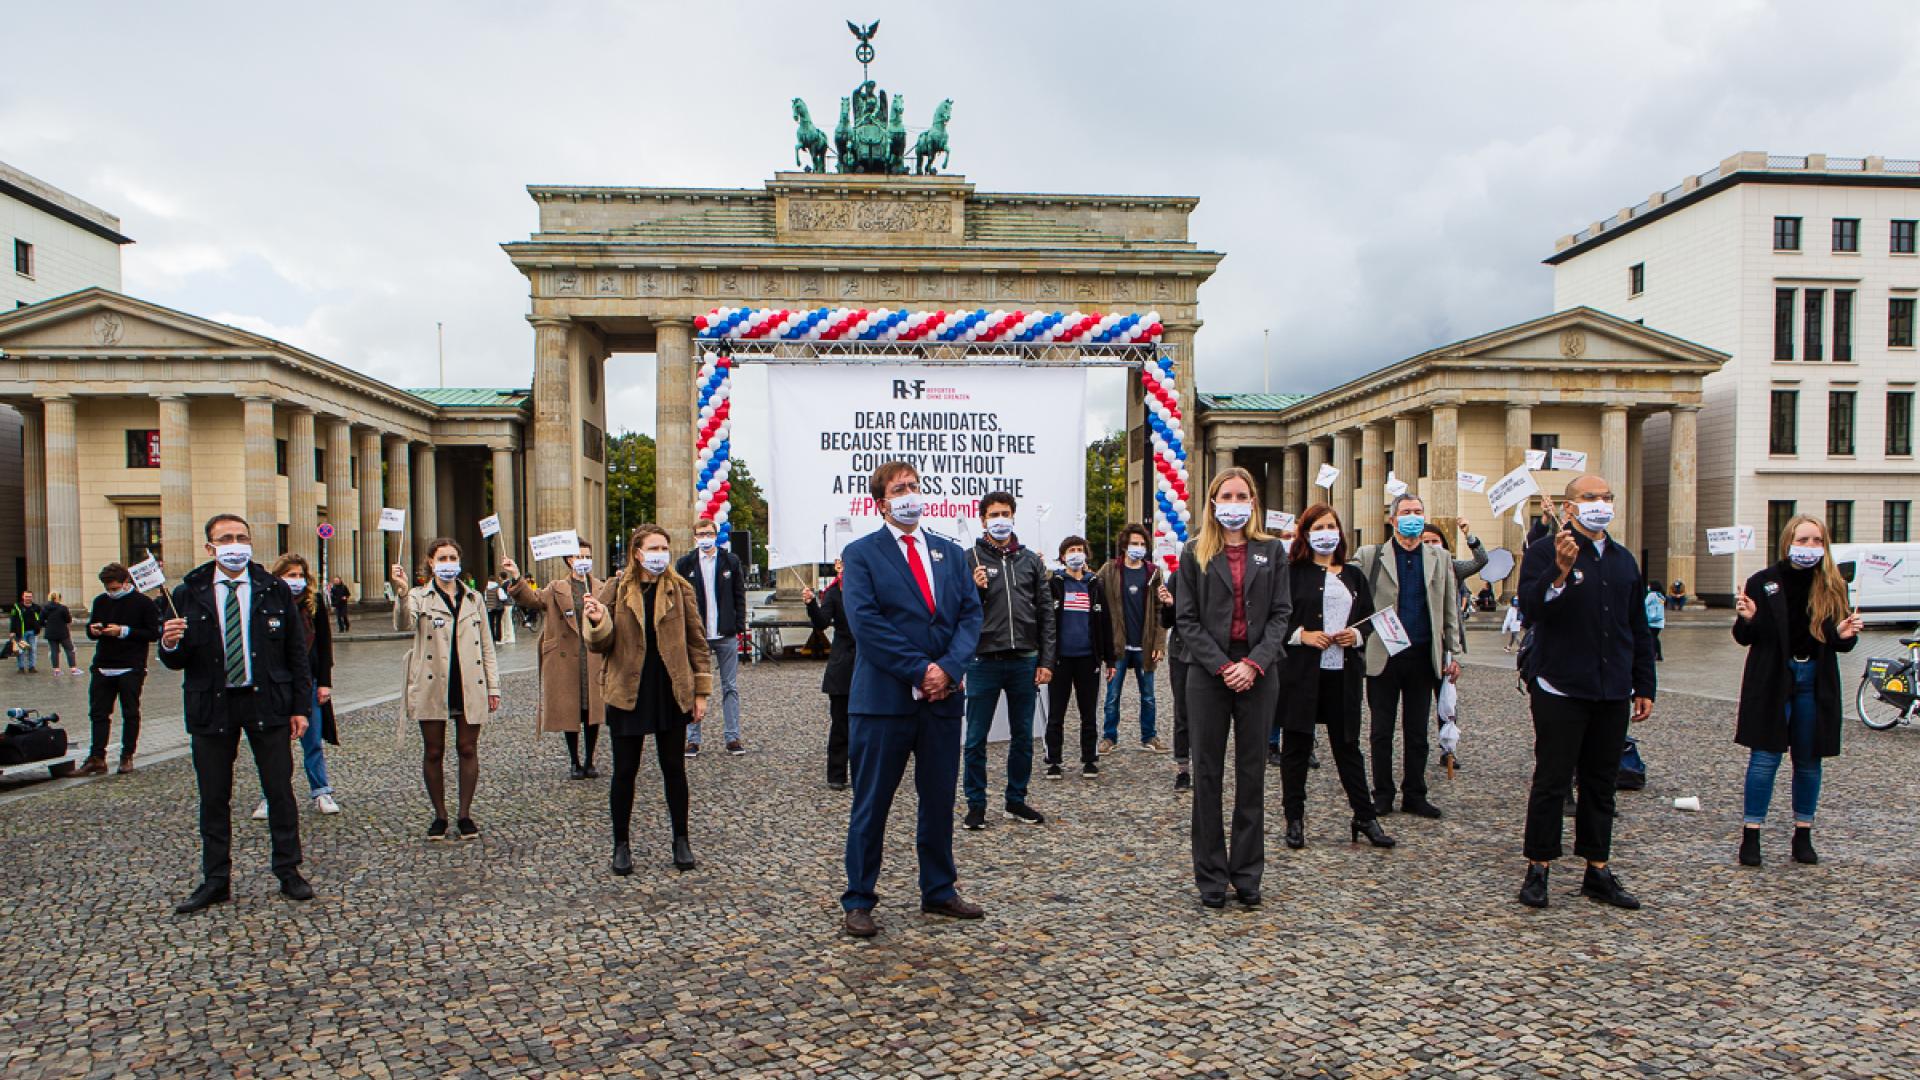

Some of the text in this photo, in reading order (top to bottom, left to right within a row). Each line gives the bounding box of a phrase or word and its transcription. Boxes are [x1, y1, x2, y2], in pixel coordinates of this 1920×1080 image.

[855, 412, 1002, 432] DEAR CANDIDATES,
[821, 432, 1036, 454] BECAUSE THERE IS NO FREE
[932, 454, 1005, 474] WITHOUT
[833, 475, 843, 494] A
[951, 477, 989, 496] SIGN
[993, 477, 1024, 498] THE
